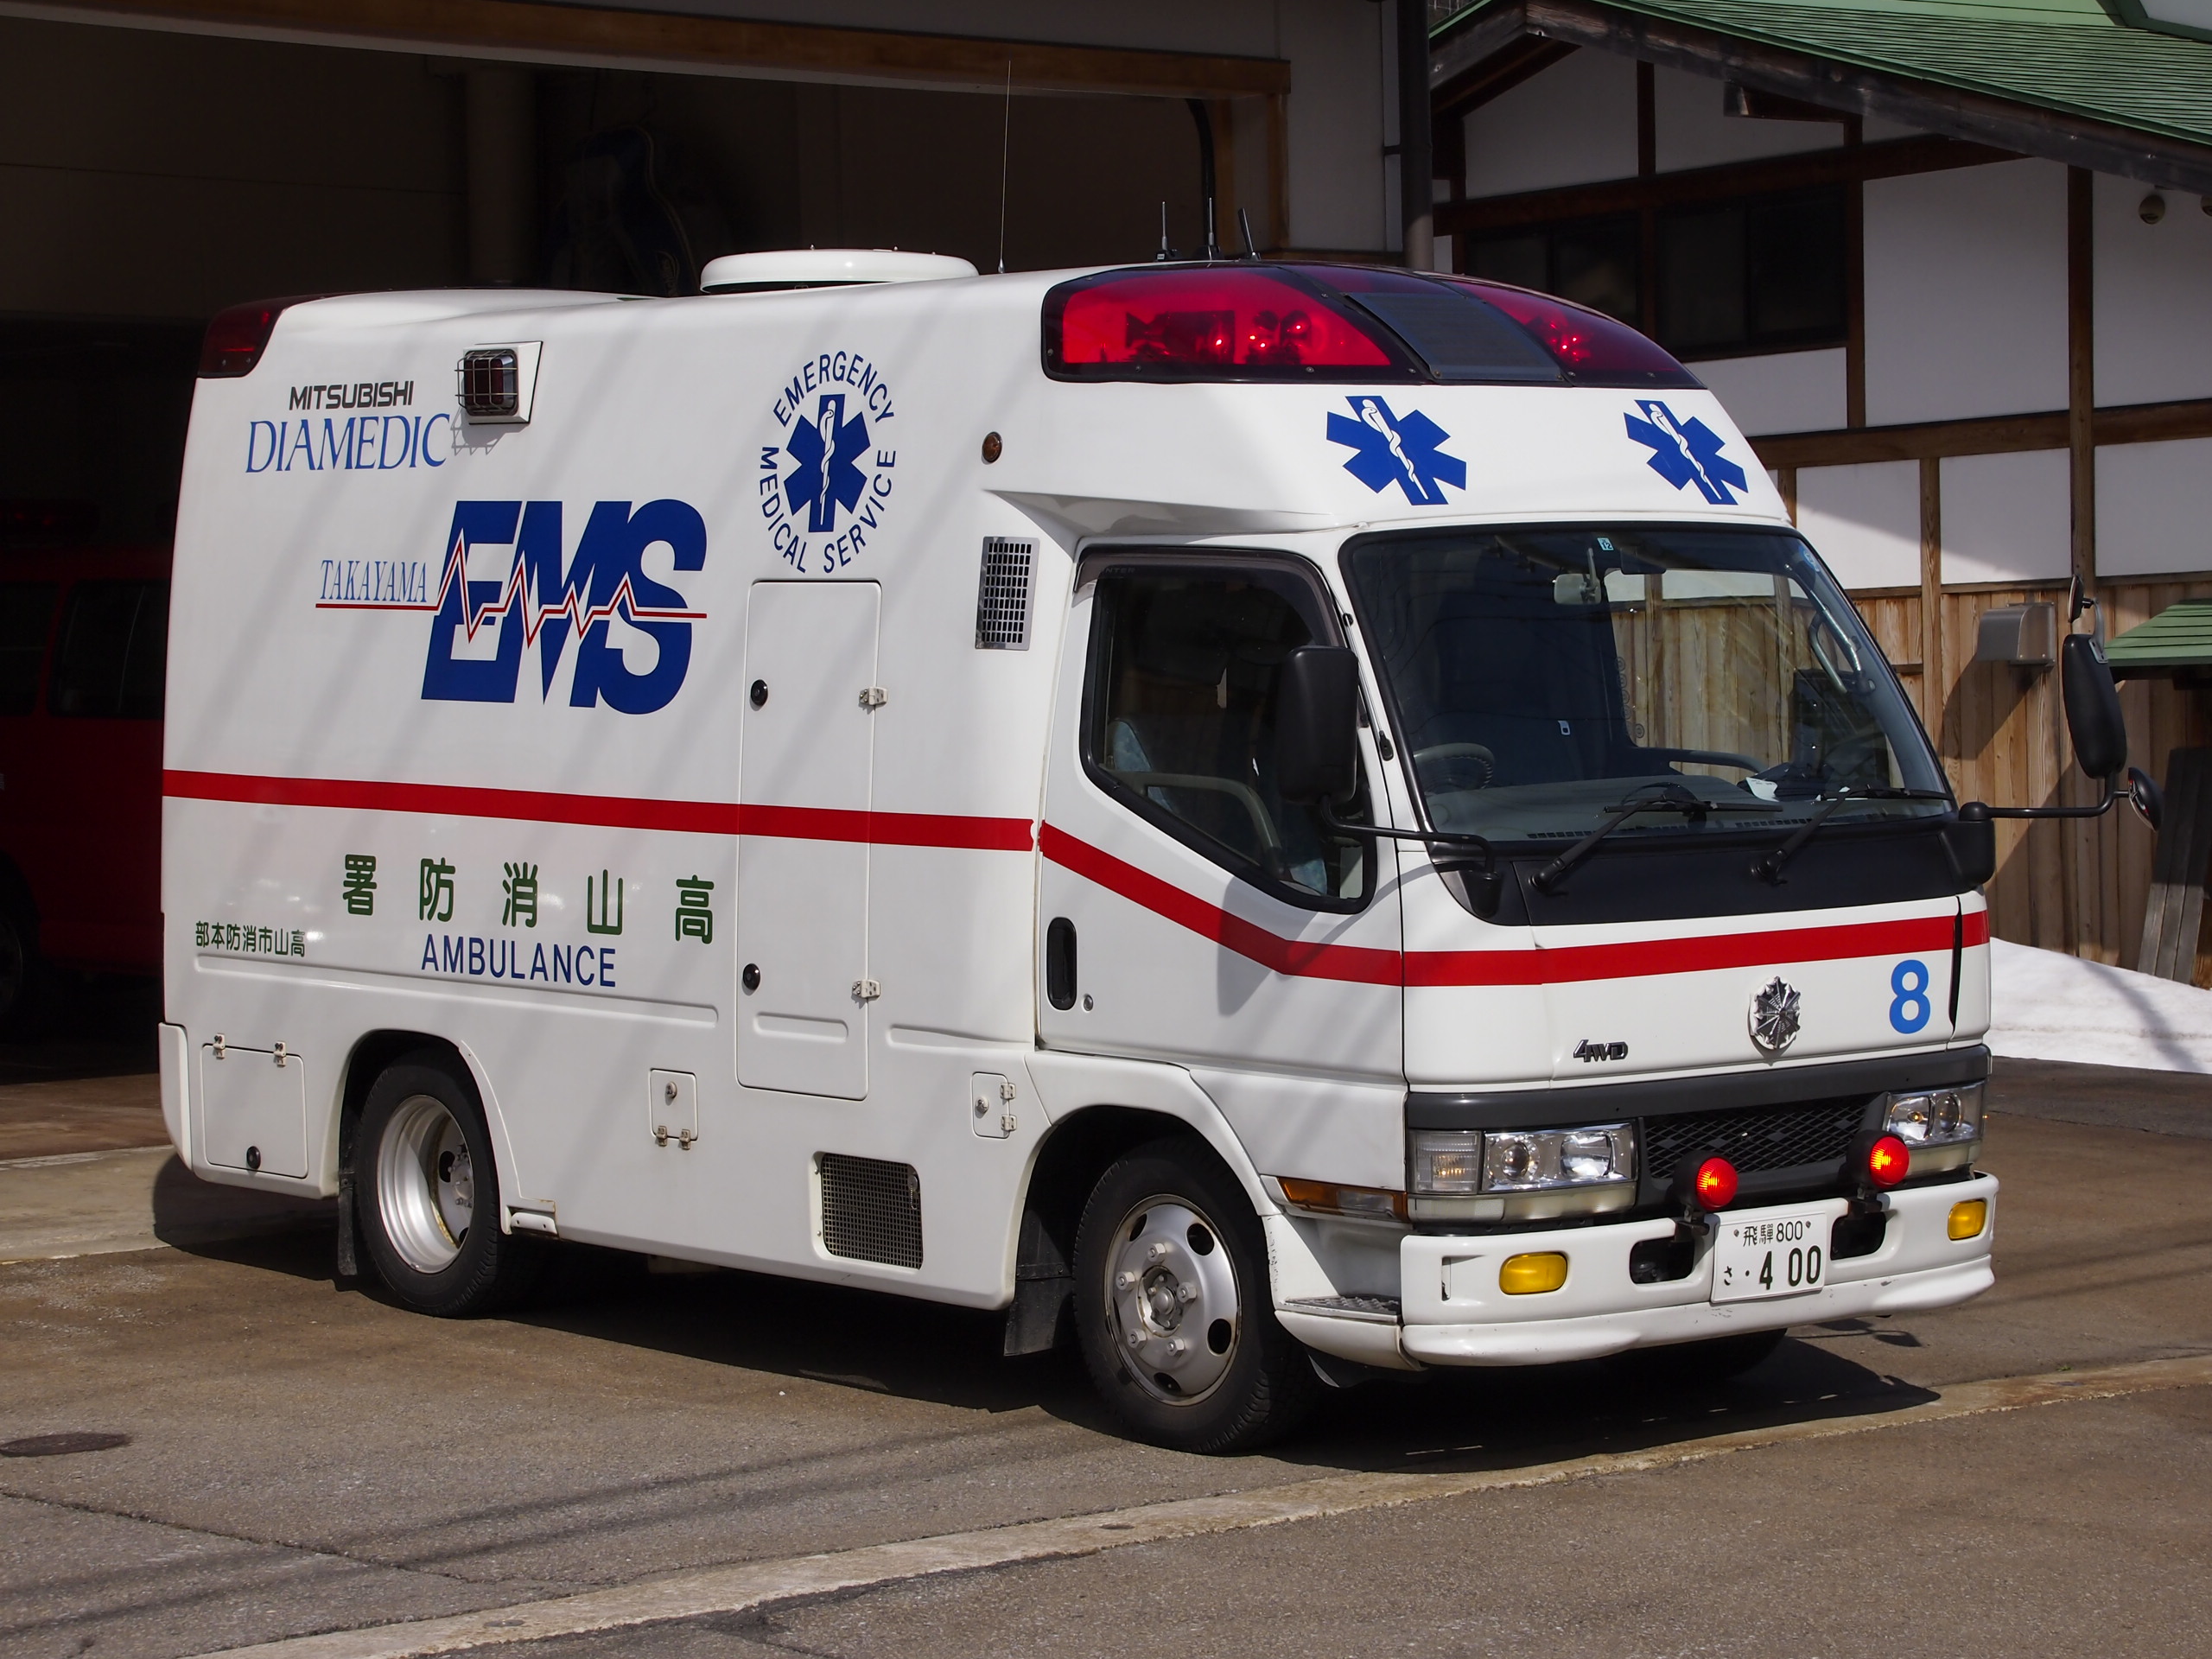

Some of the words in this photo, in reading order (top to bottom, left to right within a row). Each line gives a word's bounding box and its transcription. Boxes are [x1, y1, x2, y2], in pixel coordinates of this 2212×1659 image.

[289, 381, 415, 410] MITSUBISHI
[773, 351, 894, 428] EMERGENCY
[245, 413, 450, 473] DIAMEDIC
[760, 447, 807, 574] MEDICAL
[823, 449, 896, 574] SERVICE
[320, 559, 428, 602] TAKAYAMA
[421, 499, 707, 715] EMS
[421, 934, 616, 988] AMBULANCE
[1889, 959, 1930, 1034] 8
[1573, 1039, 1629, 1063] 4WD
[1776, 1220, 1803, 1243] 800
